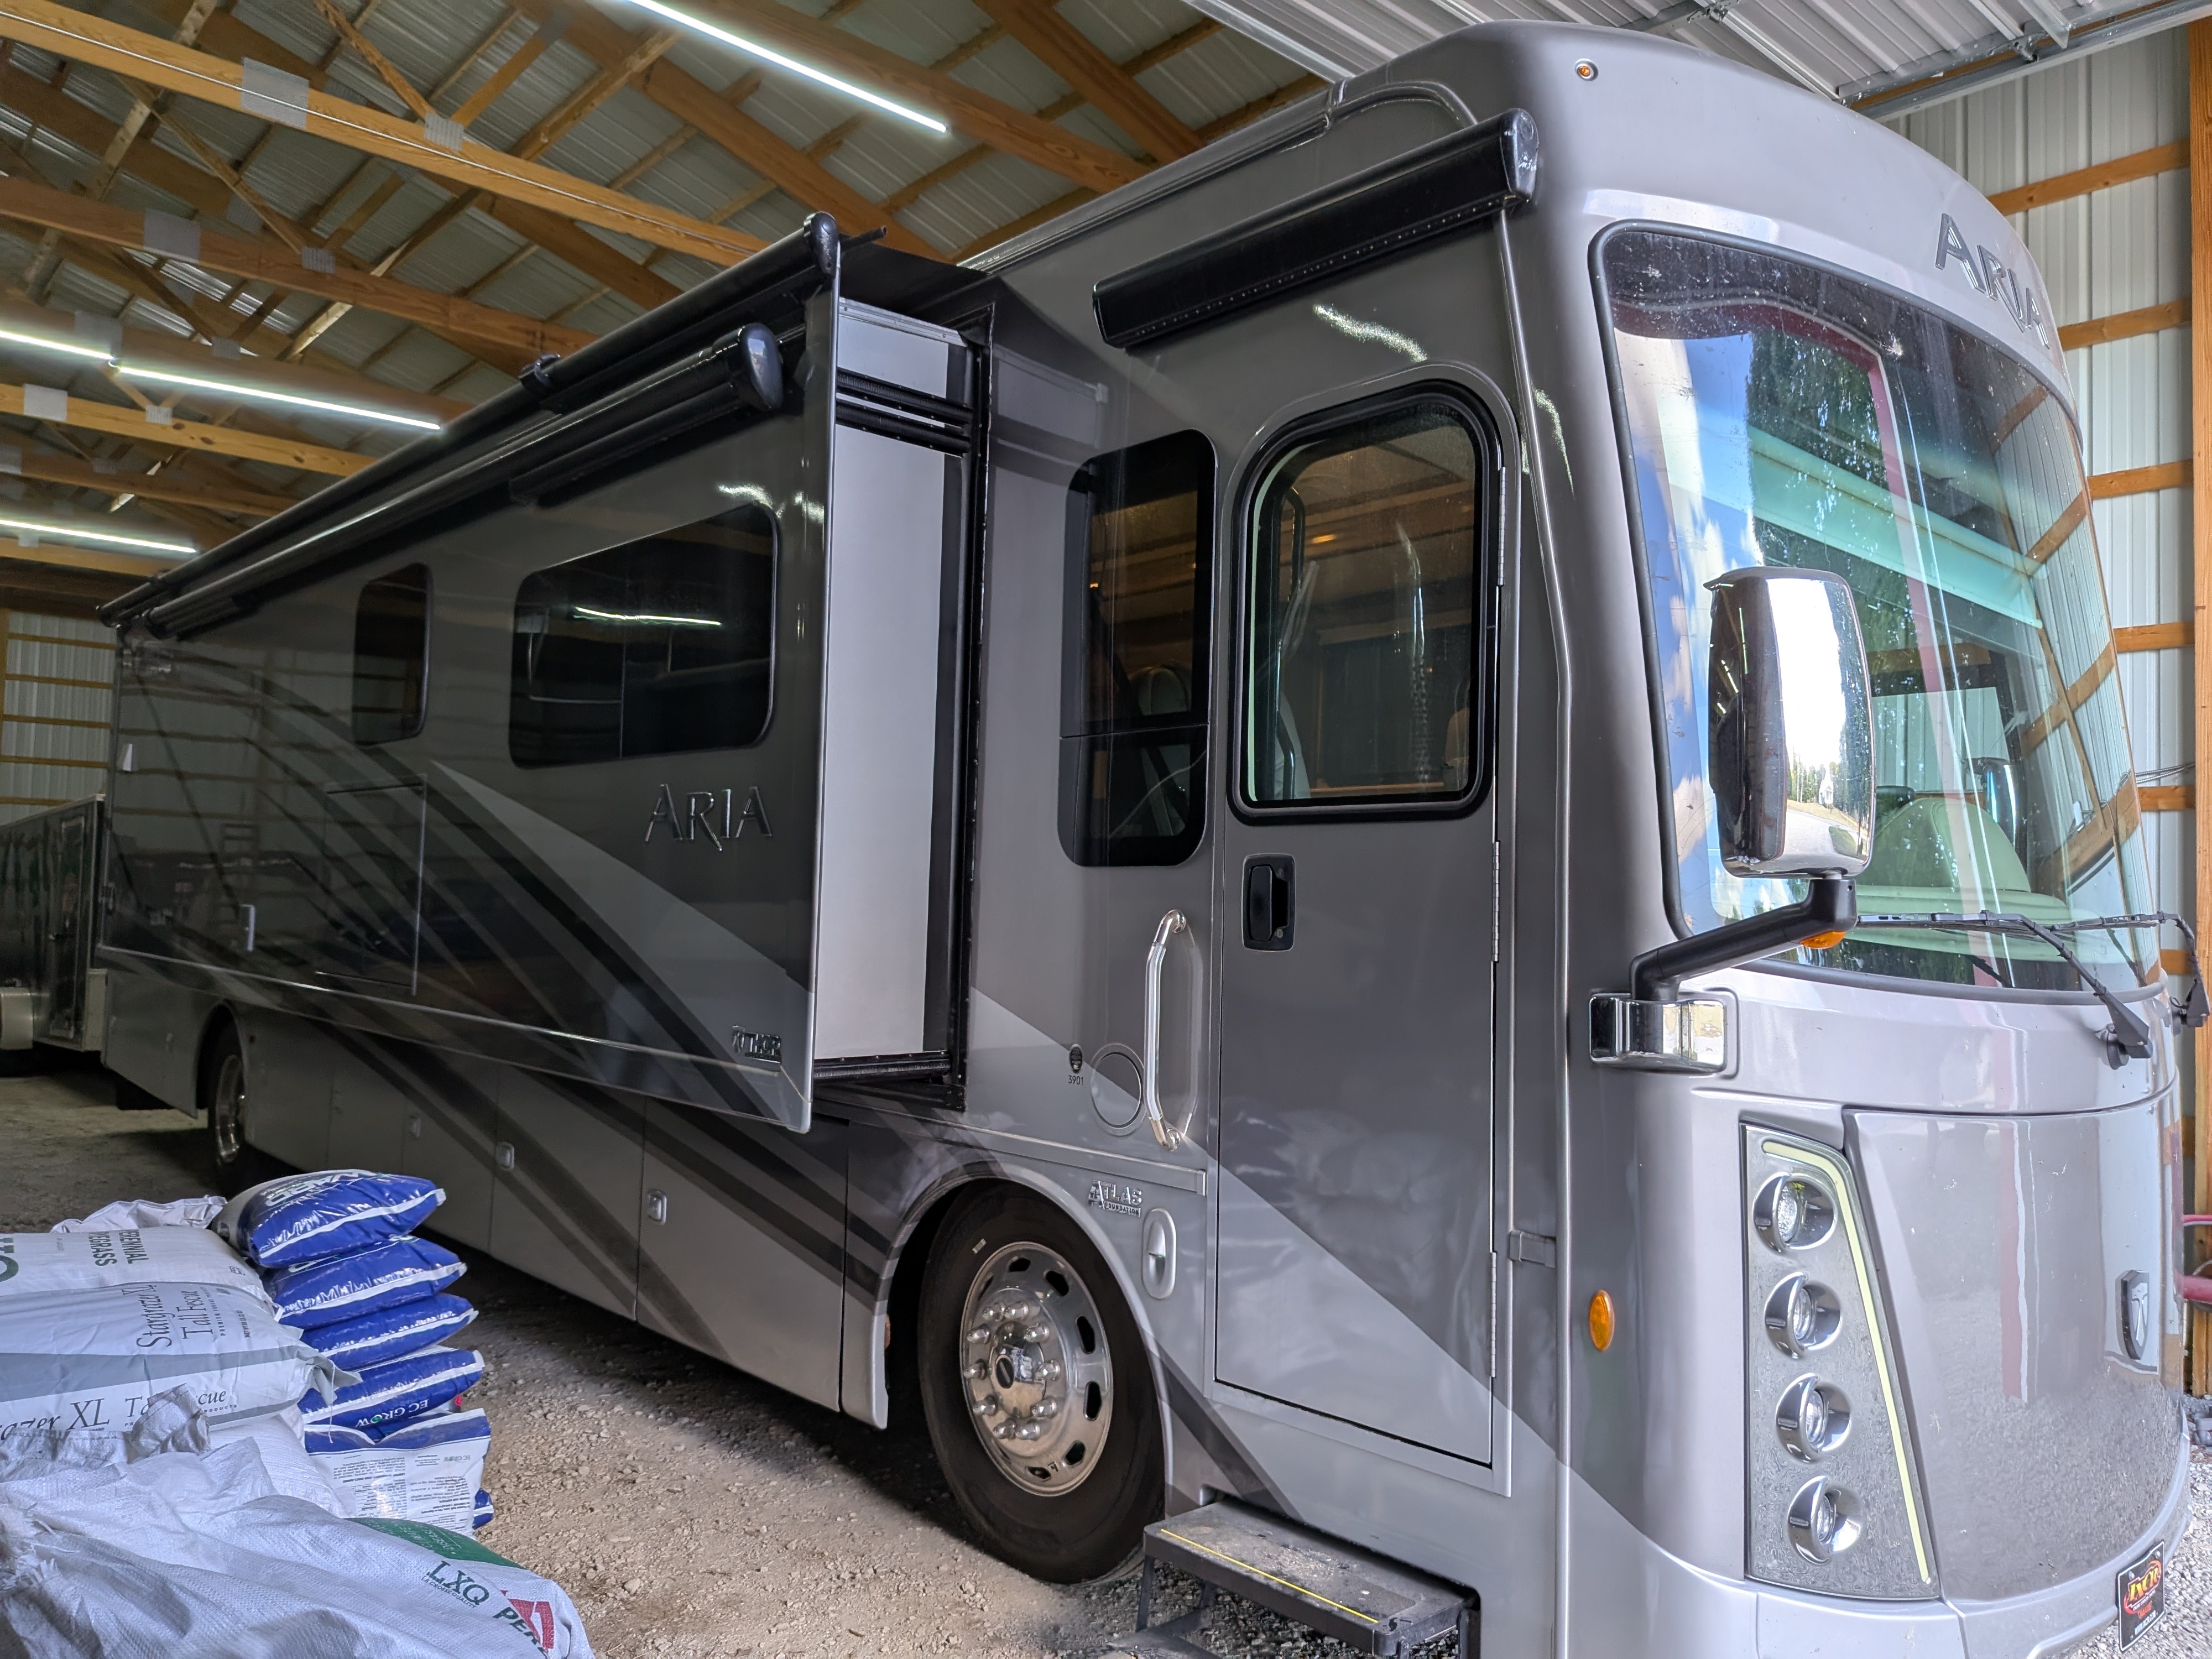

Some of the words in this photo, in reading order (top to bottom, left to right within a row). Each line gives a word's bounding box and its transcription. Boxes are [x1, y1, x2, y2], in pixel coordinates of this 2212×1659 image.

[1935, 213, 2050, 349] ARIA
[644, 782, 773, 852] ARIA
[745, 1032, 782, 1057] THOR
[1068, 1074, 1084, 1085] 3901
[1088, 1180, 1142, 1210] ATLAS
[1104, 1202, 1140, 1217] FOUNDATION
[88, 1232, 118, 1266] YEGRASS
[121, 1285, 156, 1296] XL
[175, 1291, 207, 1312] Fescue
[136, 1294, 175, 1348] Stargrazer
[176, 1313, 213, 1339] Tall
[0, 1416, 61, 1441] azer
[66, 1397, 110, 1430] XL
[124, 1396, 150, 1418] Ta
[196, 1391, 226, 1405] cue
[204, 1404, 237, 1413] RODUCTS
[354, 1406, 408, 1428] GROW
[409, 1398, 430, 1411] EC
[426, 1560, 490, 1605] LXQ
[429, 1581, 452, 1594] CROSSE
[452, 1592, 477, 1608] QUALITY
